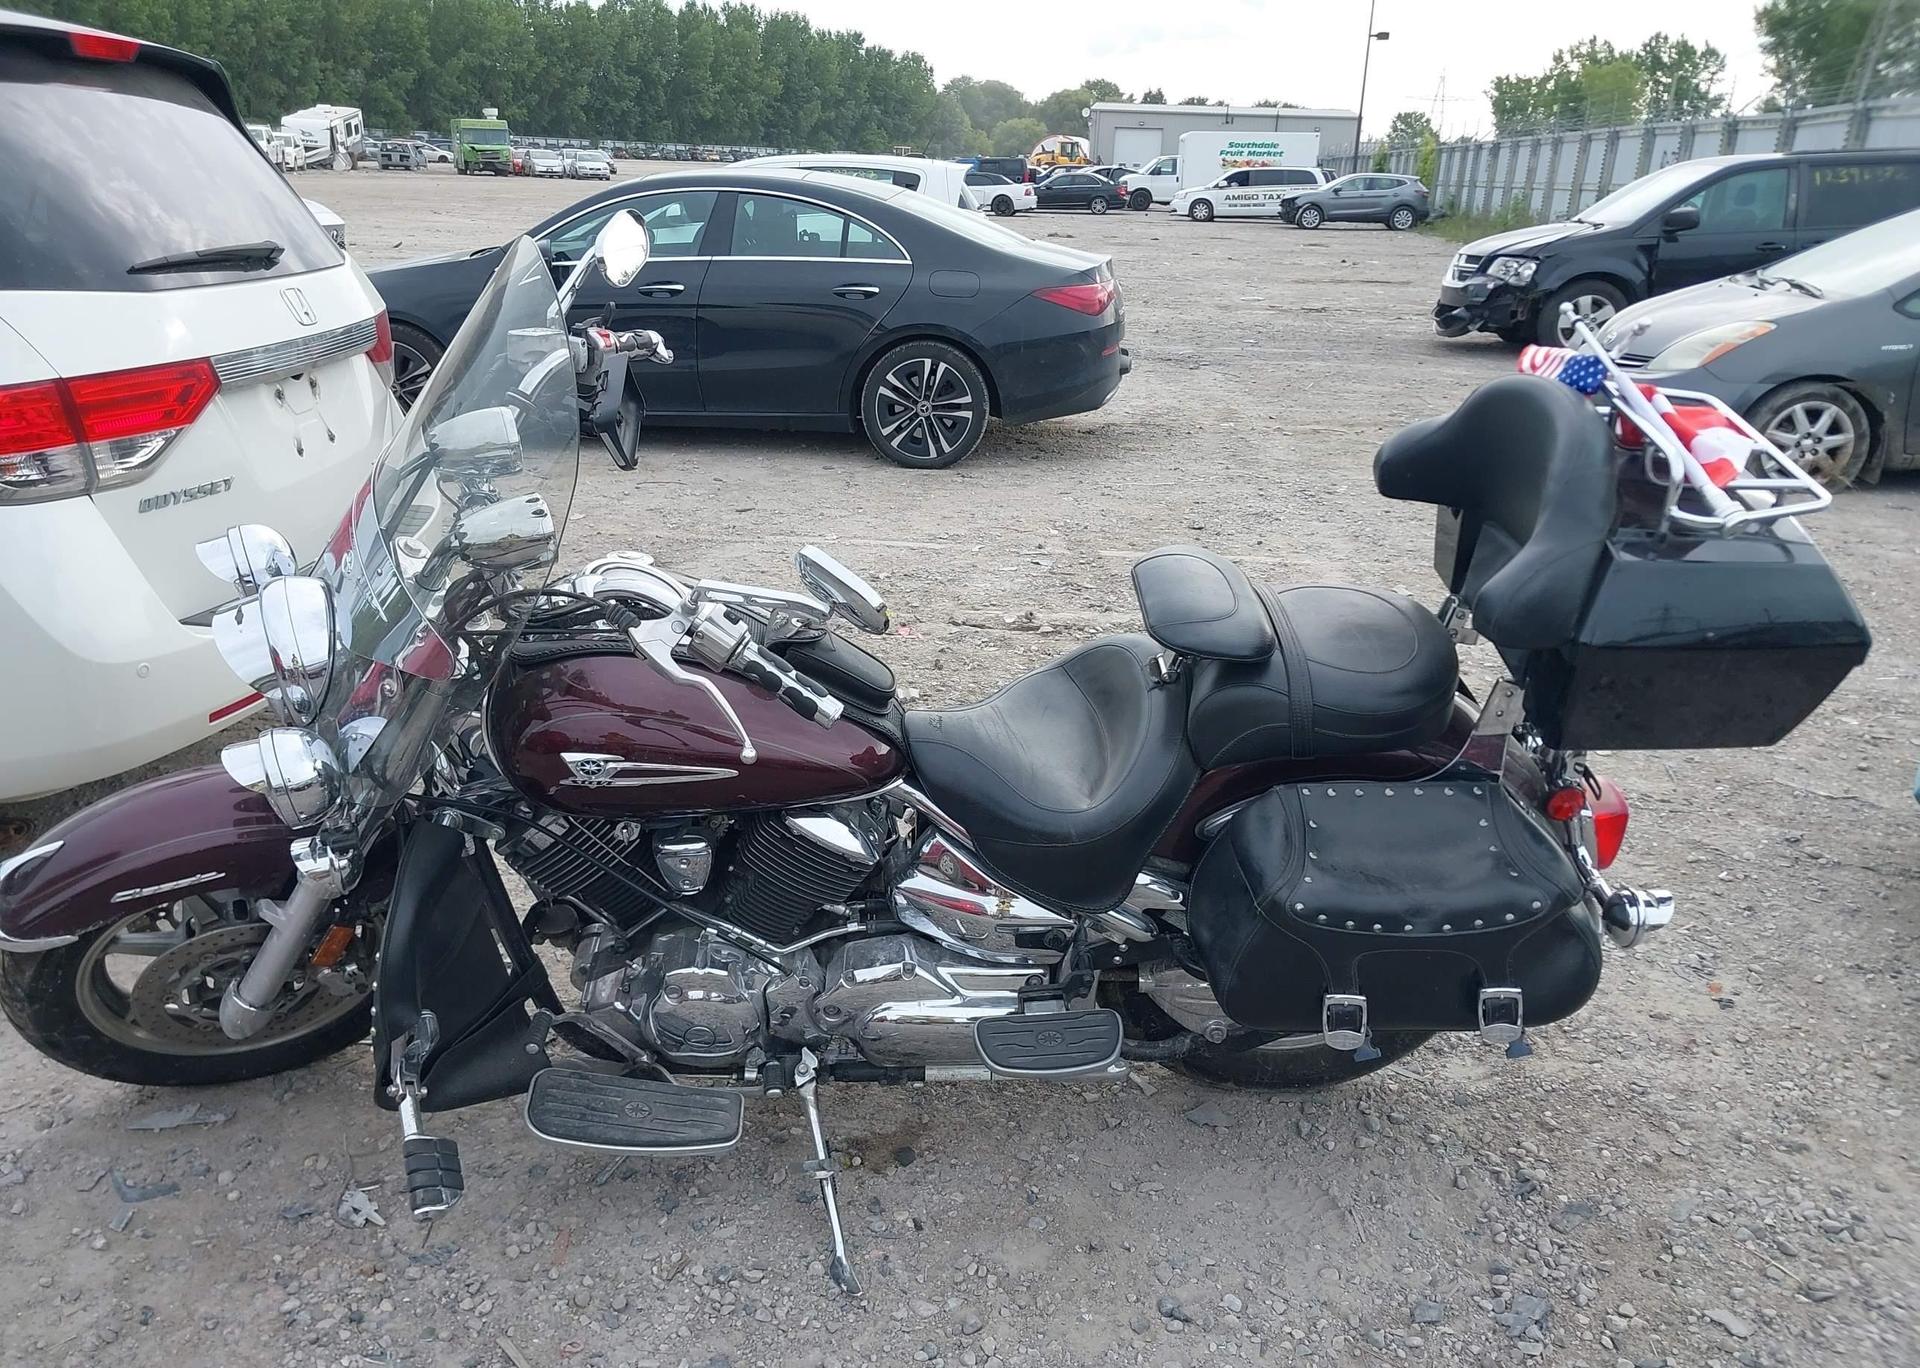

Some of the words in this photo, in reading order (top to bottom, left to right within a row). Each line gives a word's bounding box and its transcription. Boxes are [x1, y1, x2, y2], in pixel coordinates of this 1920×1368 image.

[1227, 141, 1280, 149] Southdale
[1219, 149, 1245, 157] Fruit
[1224, 193, 1259, 201] AMIGO
[138, 475, 236, 514] ODYSSEY
